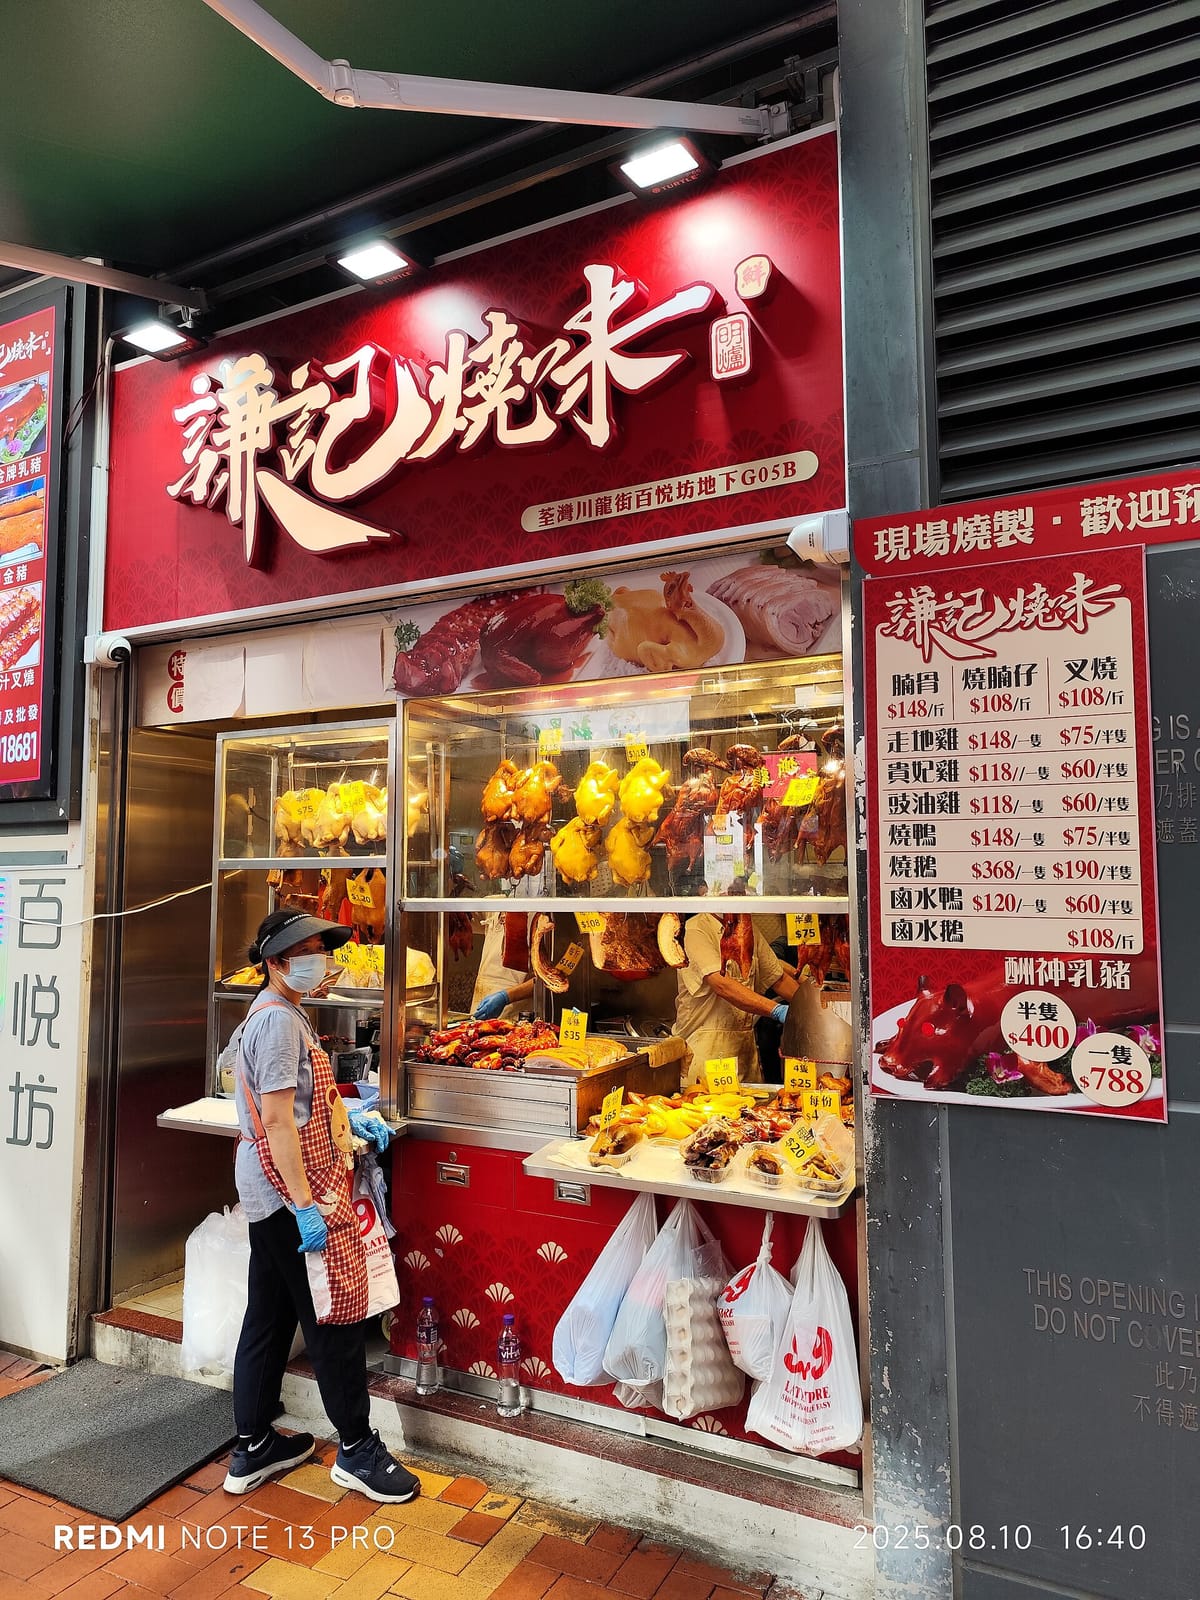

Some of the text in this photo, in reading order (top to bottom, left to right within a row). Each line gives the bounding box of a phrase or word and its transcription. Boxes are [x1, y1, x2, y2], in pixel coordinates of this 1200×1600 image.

[873, 507, 1034, 563] 現場燒製
[892, 656, 1118, 696] 腩骨 燒腩仔 叉燒
[0, 704, 38, 725] 及批發
[887, 687, 1124, 719] $148/斤 $108/斤 $108/斤
[887, 725, 1127, 753] 走地雞 $148/一隻 $75/半隻
[1169, 714, 1190, 740] IS
[0, 731, 37, 763] 18681
[887, 759, 959, 784] 貴妃雞
[1061, 758, 1128, 779] $60/半隻
[1155, 749, 1187, 775] ER
[888, 791, 1129, 815] 豉油雞 $118/一隻 $60/半隻
[889, 823, 1130, 847] 燒鴨 $148/一隻 $75/半隻
[889, 855, 1132, 880] 燒鵝 $368/一隻 $190/半隻
[973, 893, 1047, 913] $120/一隻
[1065, 894, 1133, 914] $60/半隻
[795, 928, 816, 938] $75
[1067, 928, 1135, 949] $108/斤
[1004, 956, 1131, 991] 酬神乳豬
[1017, 1002, 1058, 1021] 半隻
[564, 1030, 580, 1040] $35
[1009, 1024, 1070, 1049] $400
[1088, 1044, 1132, 1065] 一隻
[714, 1076, 733, 1087] $60
[790, 1078, 812, 1089] $25
[1080, 1067, 1144, 1094] $788
[785, 1137, 805, 1158] $20
[1023, 1268, 1072, 1301] THIS
[1080, 1277, 1186, 1319] OPENING
[1033, 1304, 1066, 1334] DO
[1074, 1311, 1121, 1343] NOT
